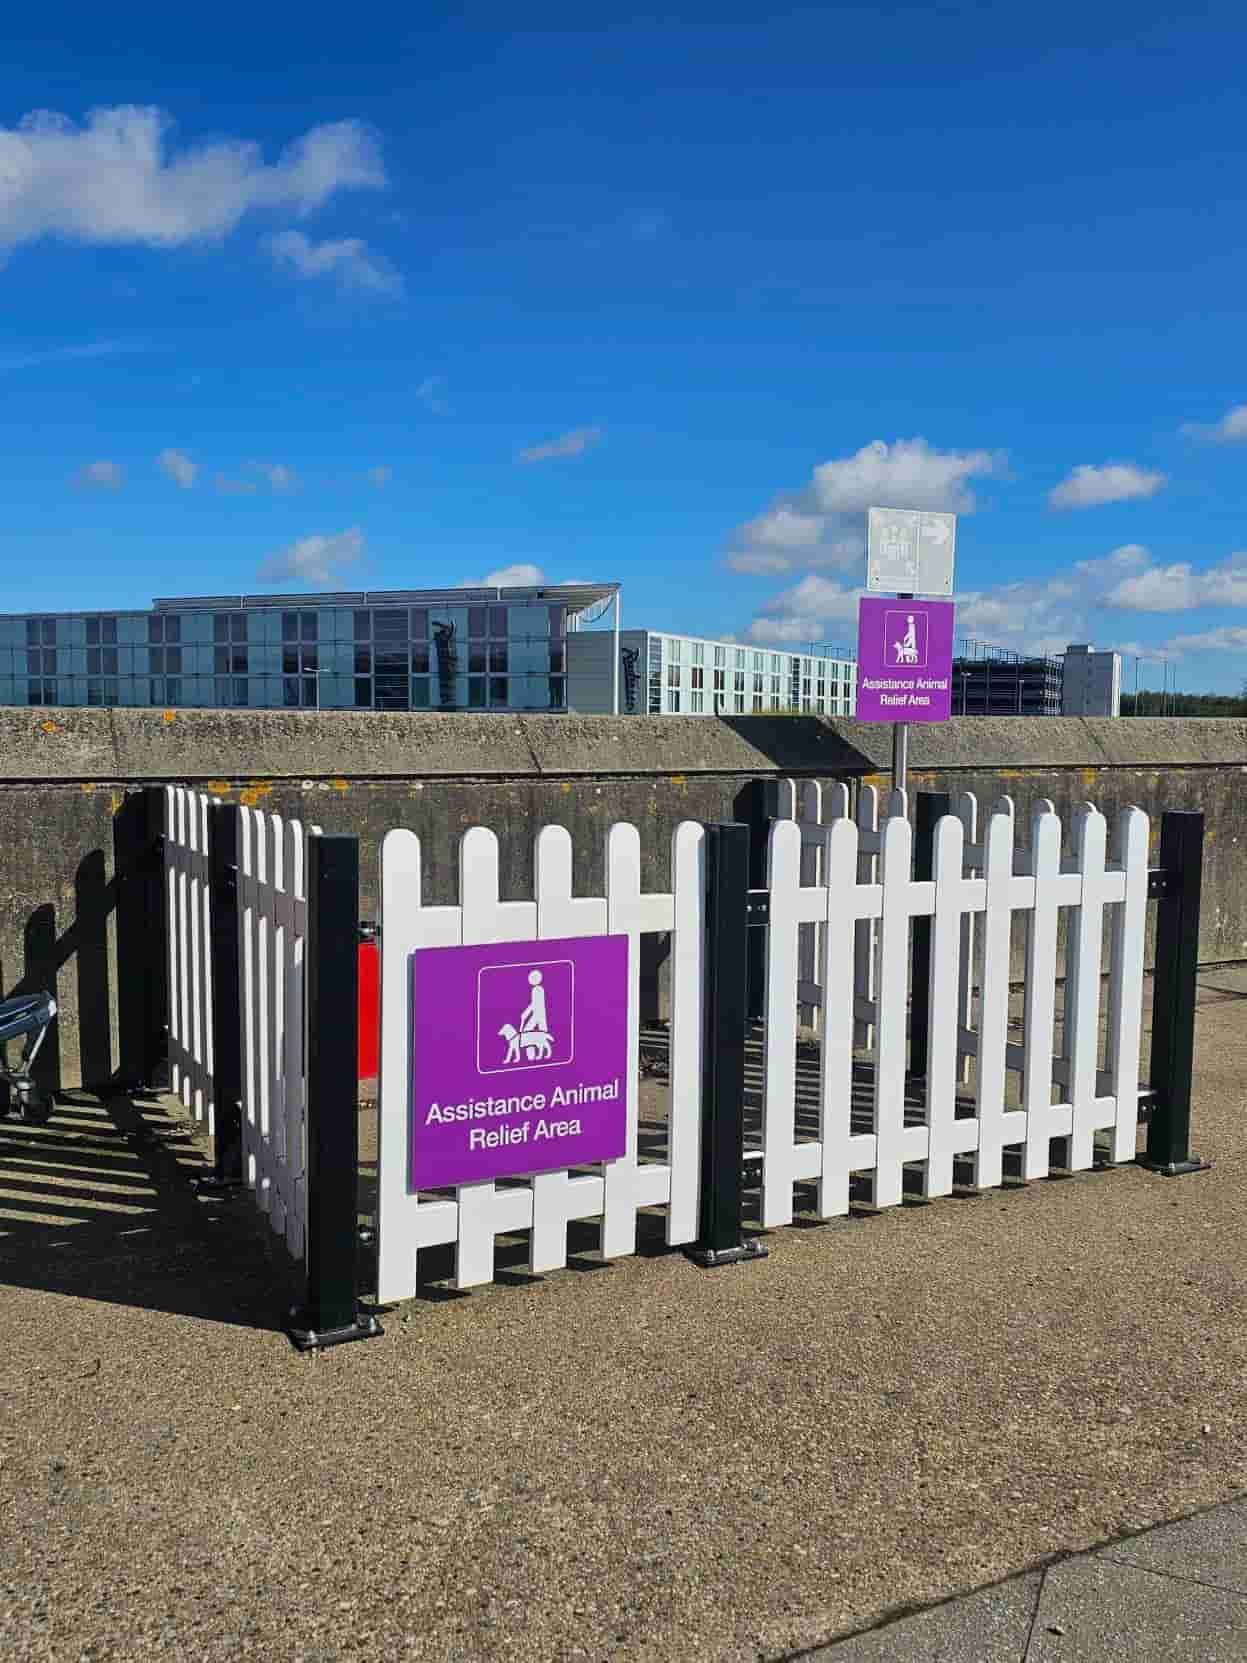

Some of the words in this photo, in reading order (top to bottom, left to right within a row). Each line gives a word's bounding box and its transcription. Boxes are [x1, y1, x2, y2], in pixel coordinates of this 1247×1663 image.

[862, 677, 914, 689] Assistance
[916, 677, 948, 689] Animal
[880, 694, 907, 705] Relief
[908, 694, 930, 705] Area
[425, 1094, 546, 1126] Assistance
[550, 1079, 619, 1108] Animal
[469, 1121, 529, 1151] Relief
[533, 1118, 580, 1141] Area
